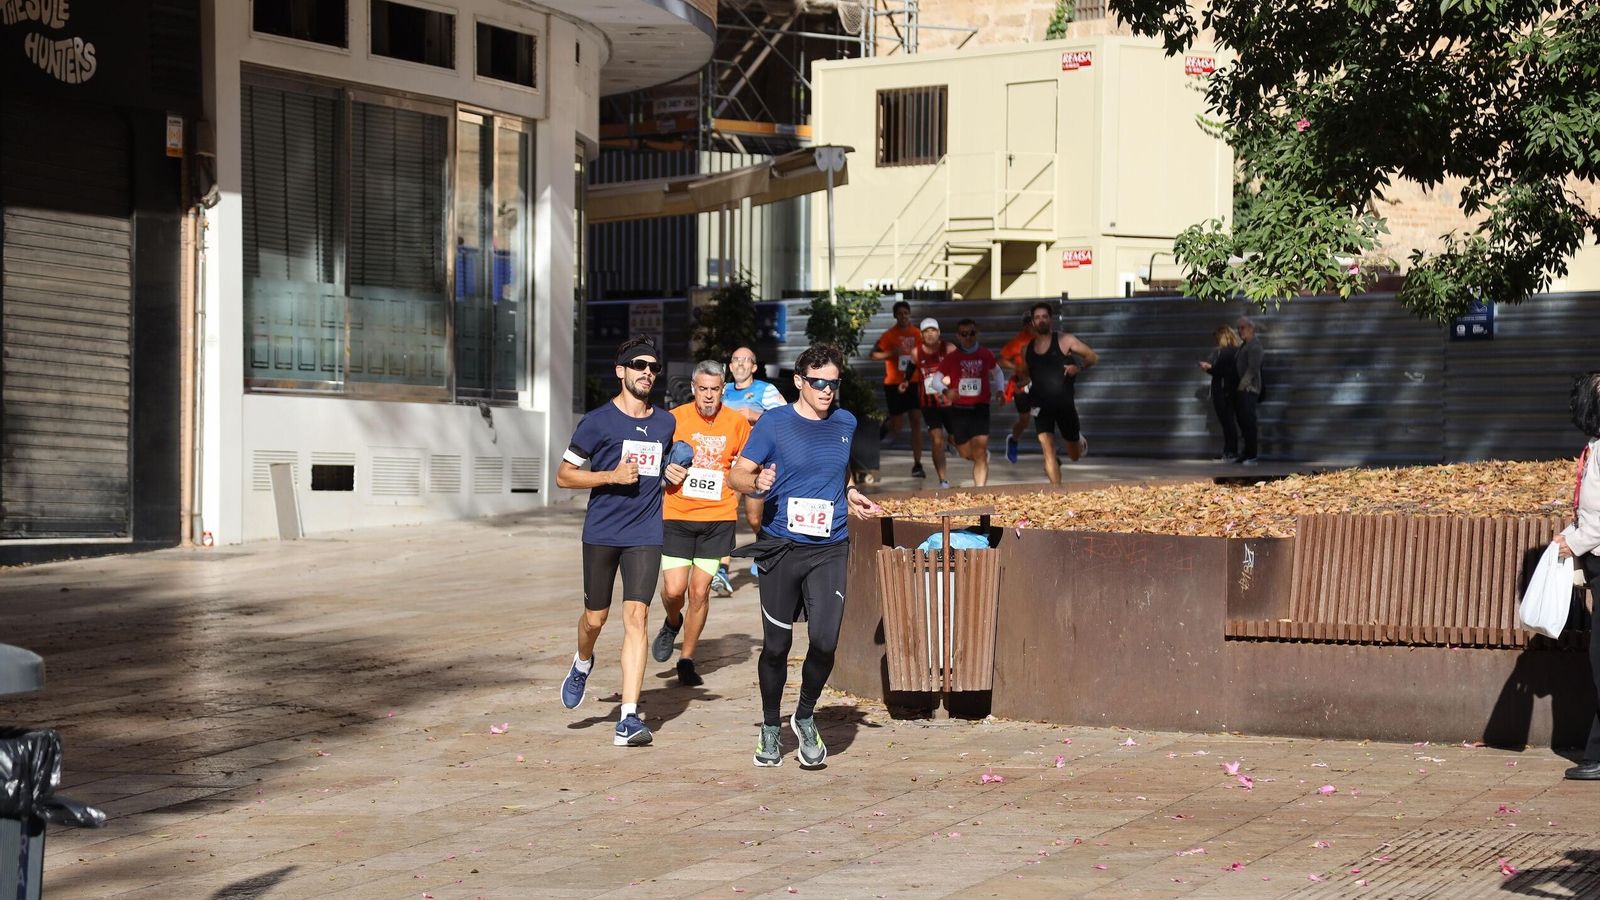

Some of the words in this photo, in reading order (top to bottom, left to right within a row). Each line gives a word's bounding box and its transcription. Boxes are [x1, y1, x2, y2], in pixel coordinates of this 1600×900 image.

[24, 32, 97, 84] HUNTERS
[1062, 51, 1092, 64] REMSA
[1185, 56, 1215, 69] REMSA
[1063, 250, 1092, 261] REMSA
[629, 453, 655, 466] 531
[689, 478, 716, 490] 862
